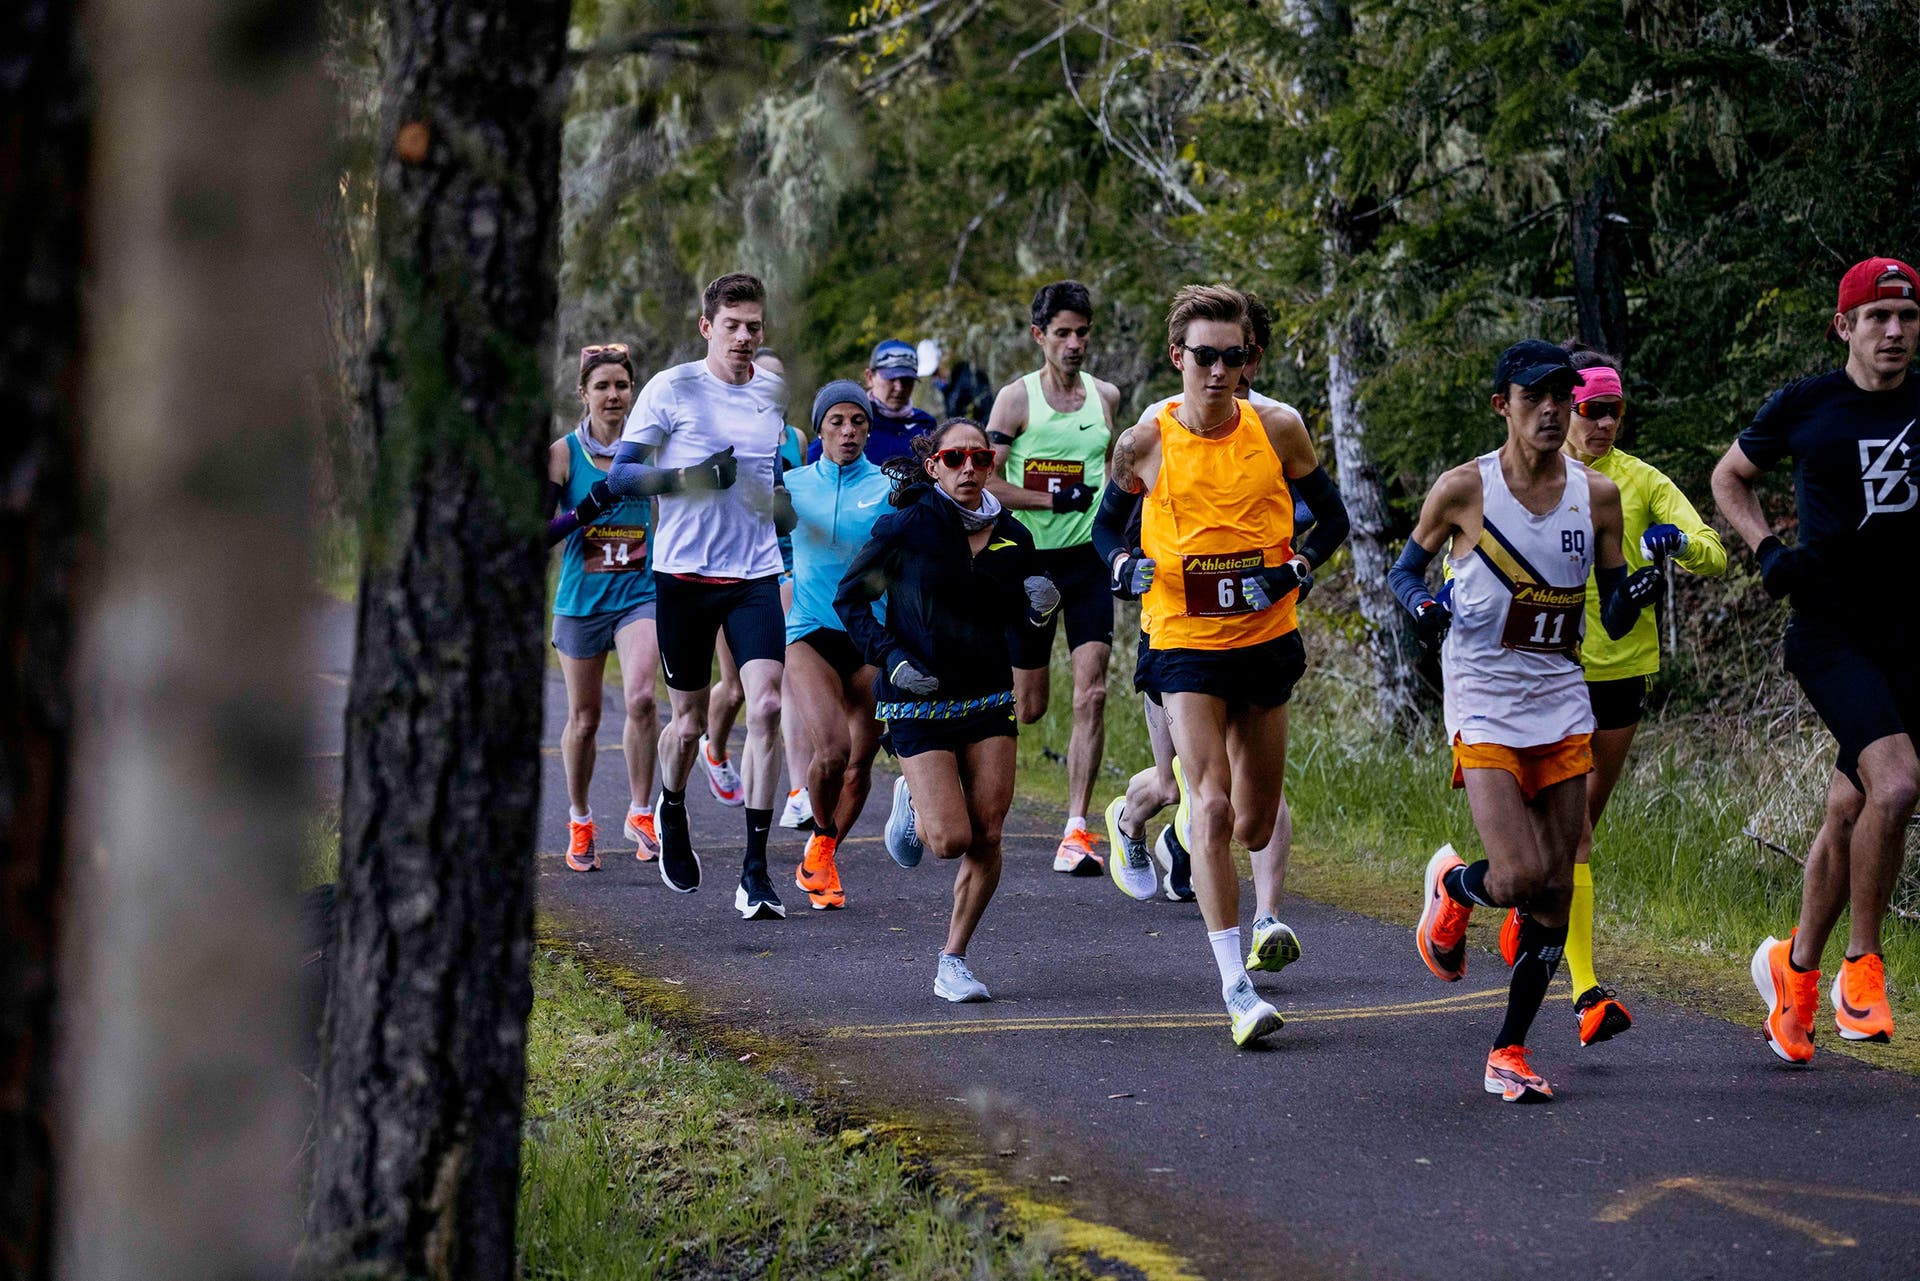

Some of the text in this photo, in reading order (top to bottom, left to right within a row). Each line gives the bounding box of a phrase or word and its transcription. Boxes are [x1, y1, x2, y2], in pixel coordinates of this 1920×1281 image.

[602, 543, 629, 565] 14
[1561, 530, 1585, 556] BQ
[1218, 578, 1235, 608] 6
[1529, 612, 1565, 643] 11
